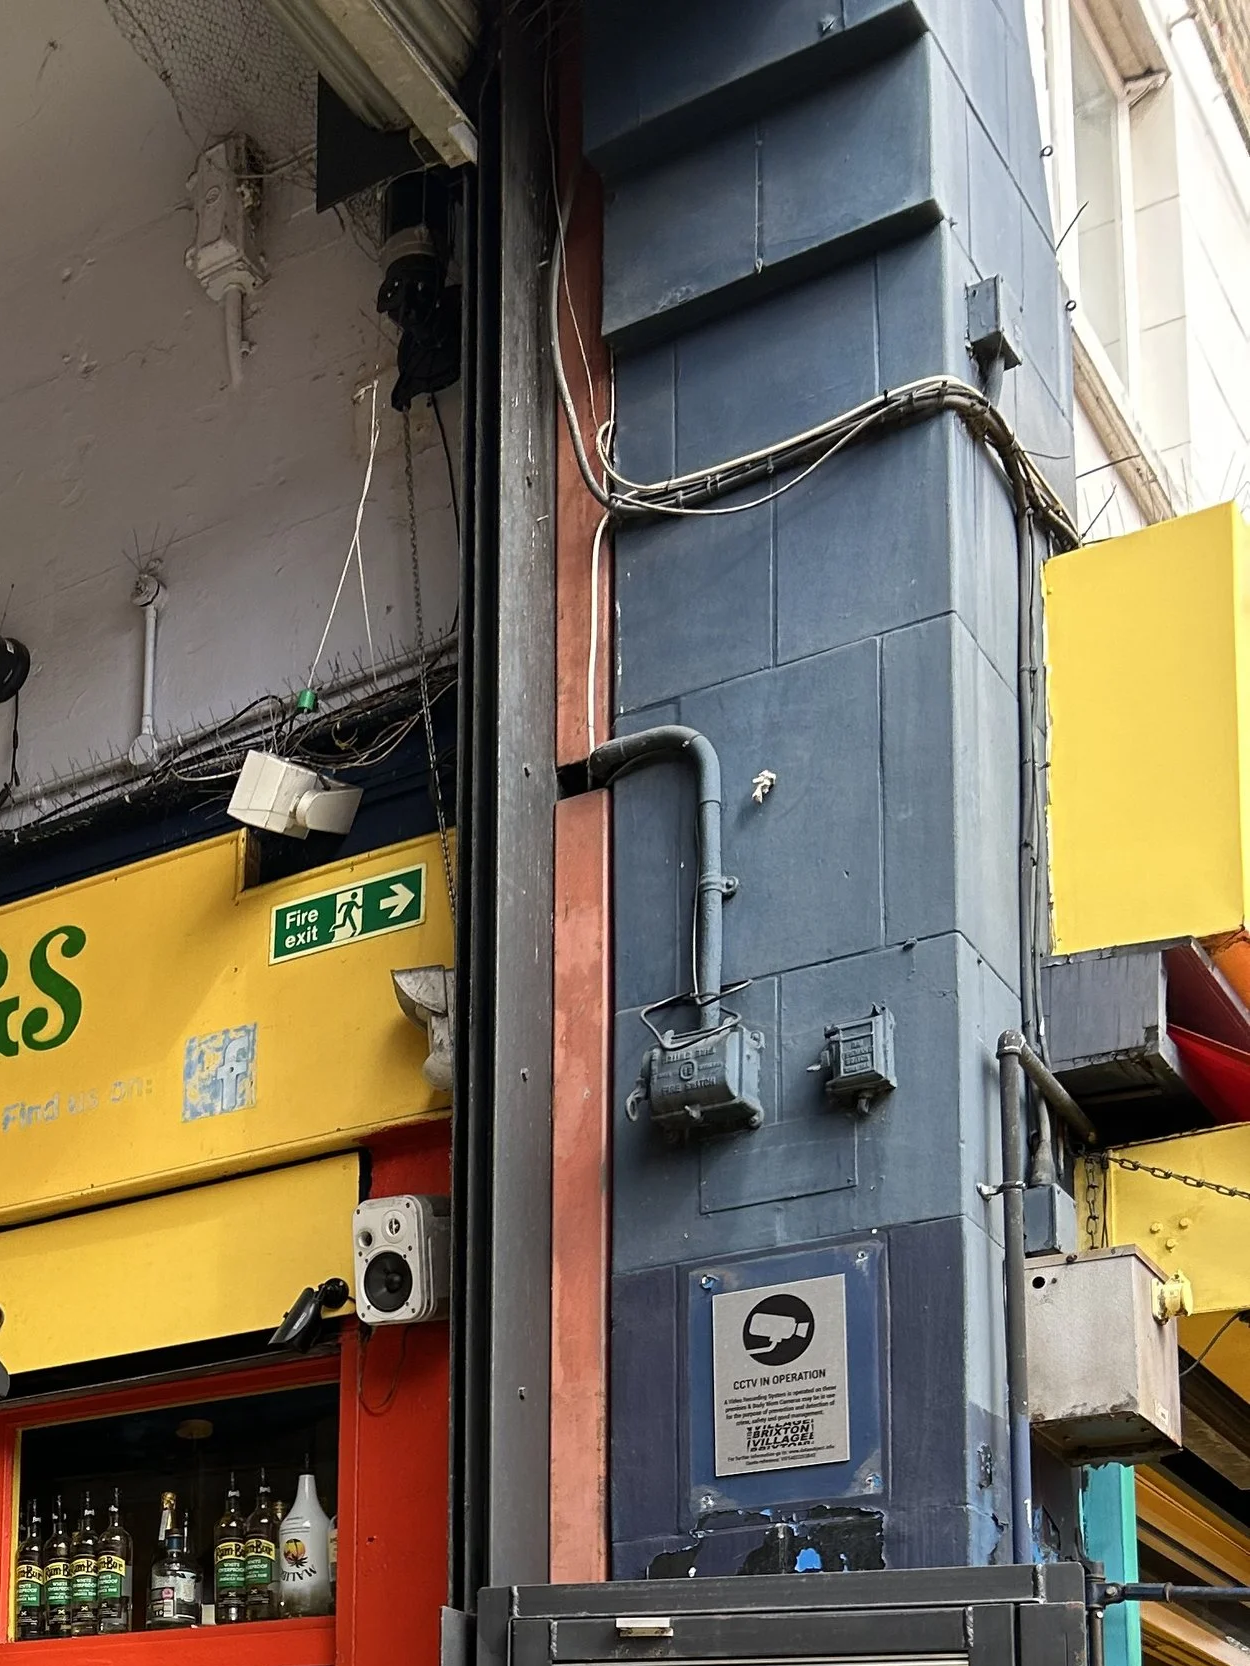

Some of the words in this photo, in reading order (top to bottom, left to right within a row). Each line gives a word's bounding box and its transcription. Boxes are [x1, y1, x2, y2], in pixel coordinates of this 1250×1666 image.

[285, 908, 319, 930] Fire
[284, 926, 319, 949] exit
[1, 1094, 59, 1133] Find
[67, 1087, 99, 1115] us
[733, 1378, 758, 1390] CCTV
[760, 1377, 770, 1387] IN
[772, 1369, 826, 1385] OPERATION
[752, 1424, 810, 1439] BRIXTON
[752, 1432, 810, 1447] VILLAGE
[281, 1564, 317, 1582] MALIB
